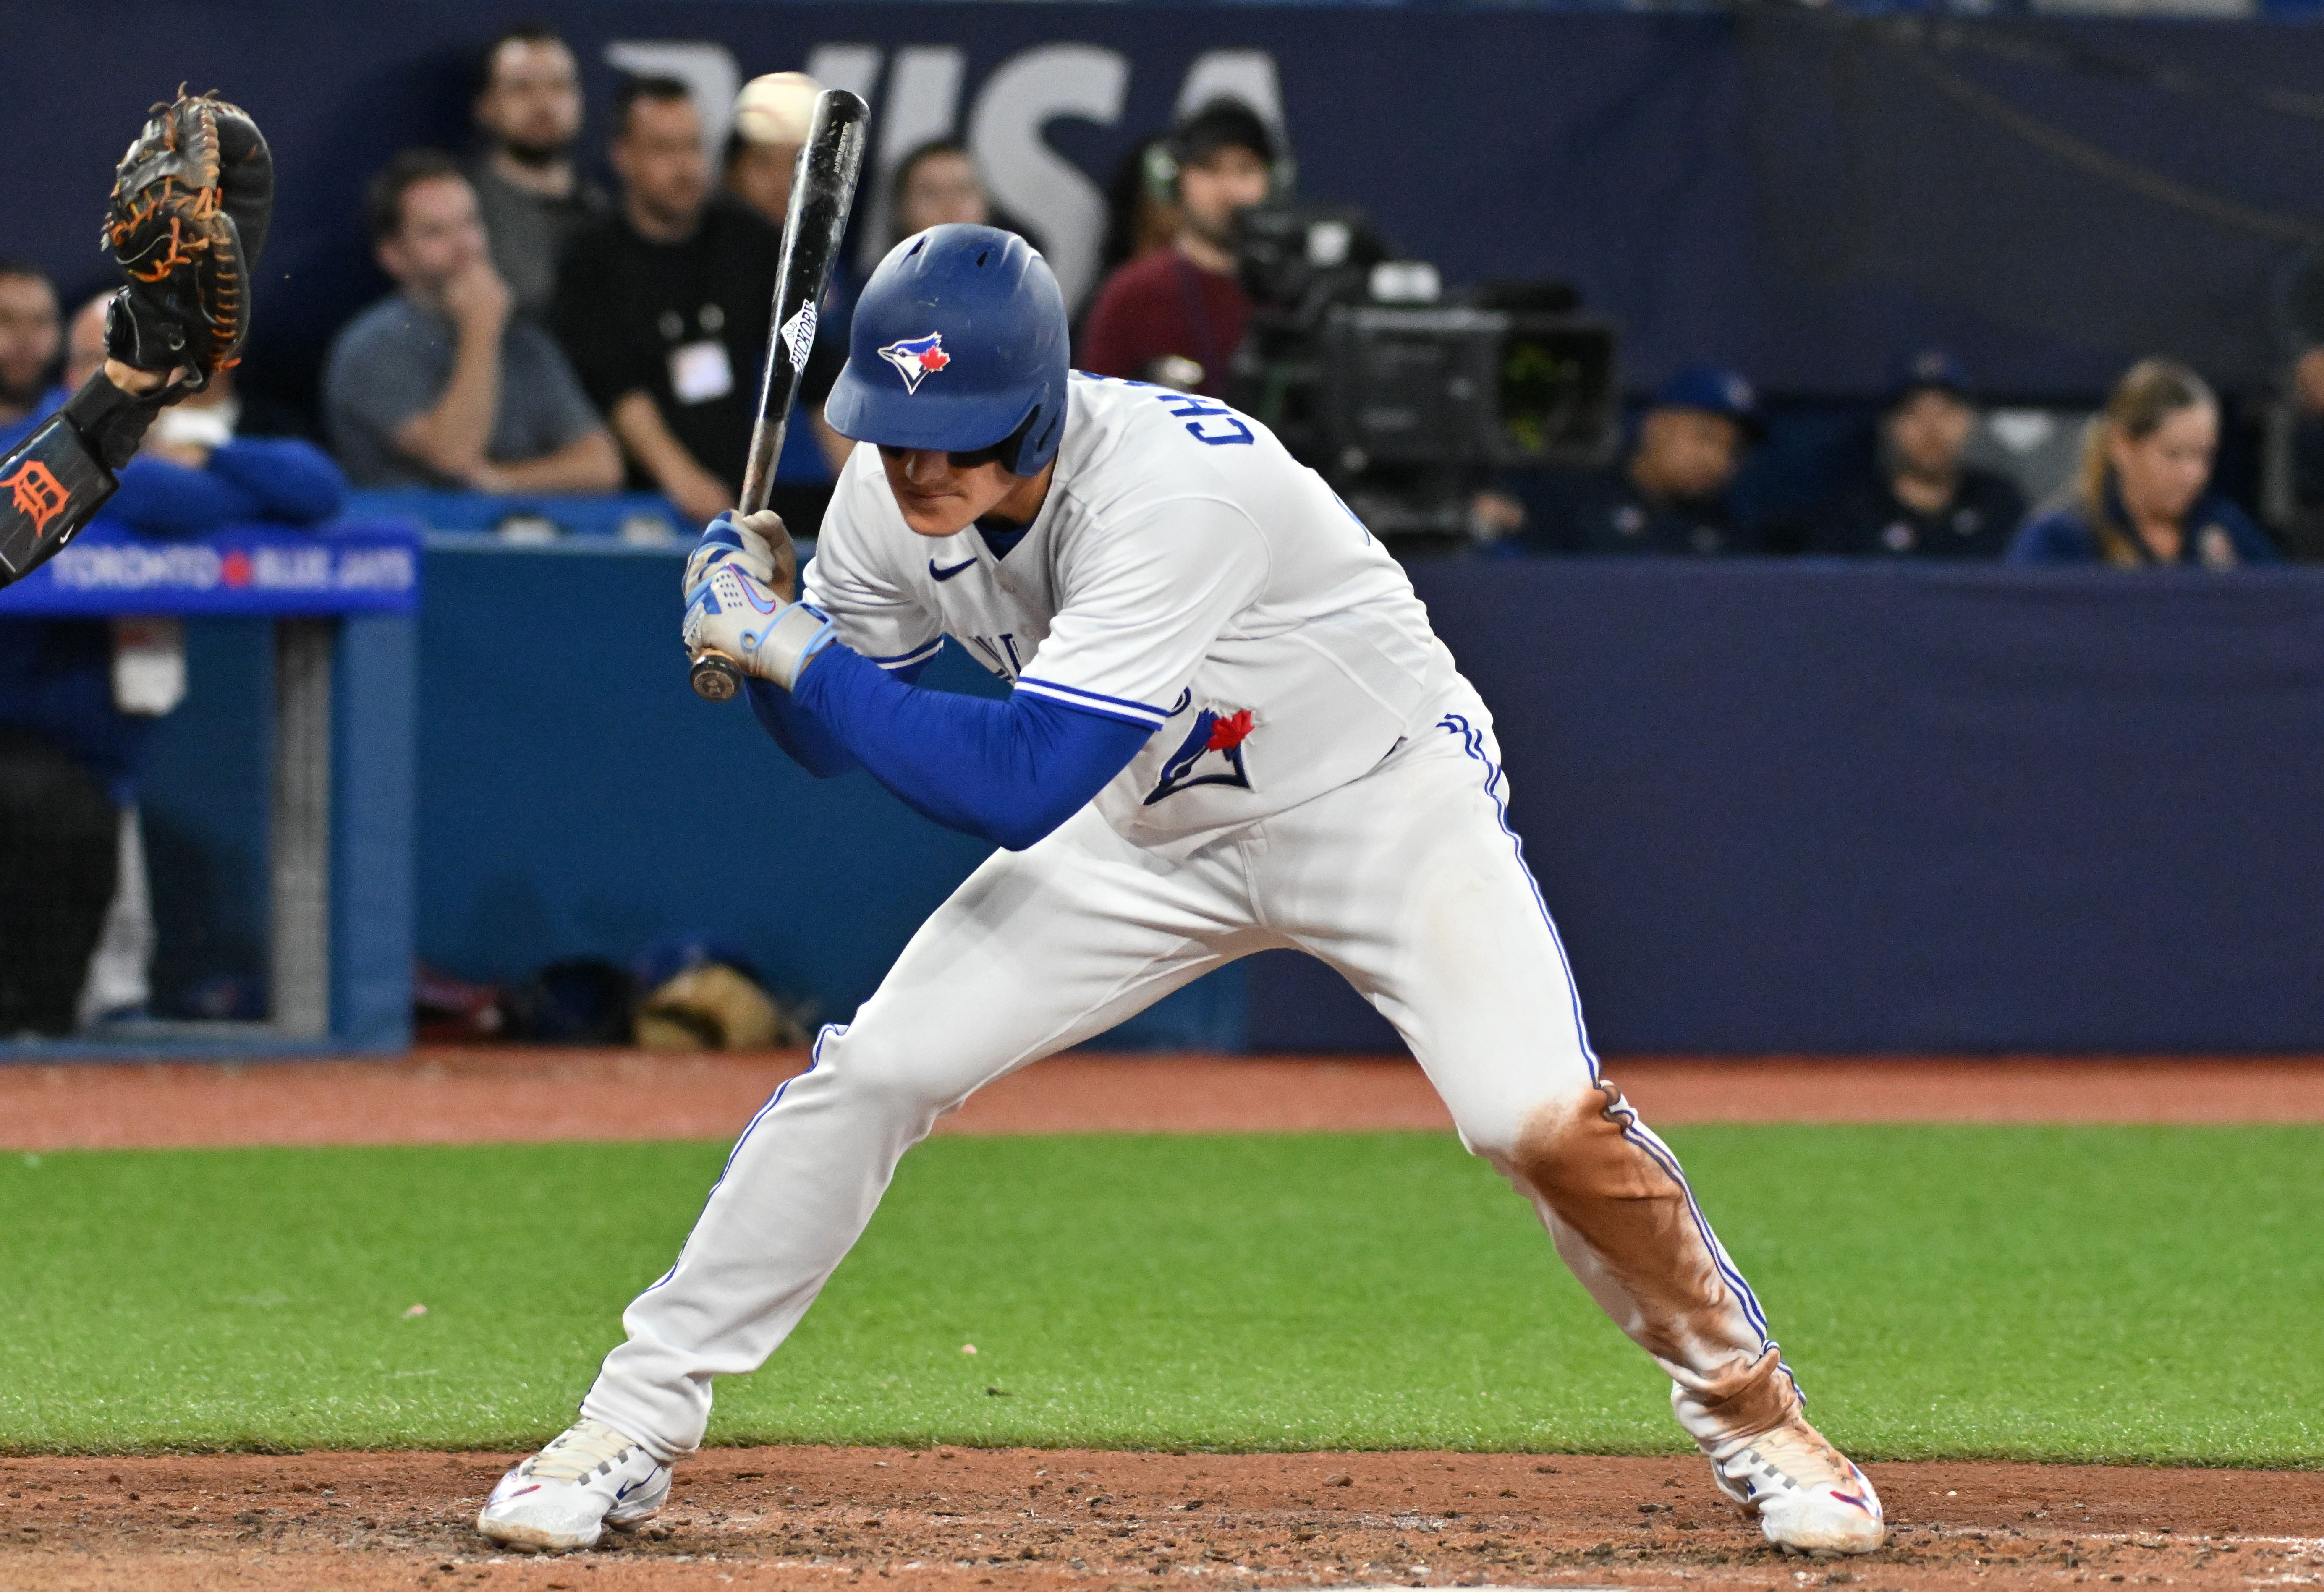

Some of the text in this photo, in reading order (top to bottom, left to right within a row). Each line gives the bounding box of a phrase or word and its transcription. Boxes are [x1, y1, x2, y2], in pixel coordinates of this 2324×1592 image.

[603, 41, 1295, 311] VIS
[786, 322, 797, 338] OLD
[791, 301, 817, 374] HICKORY
